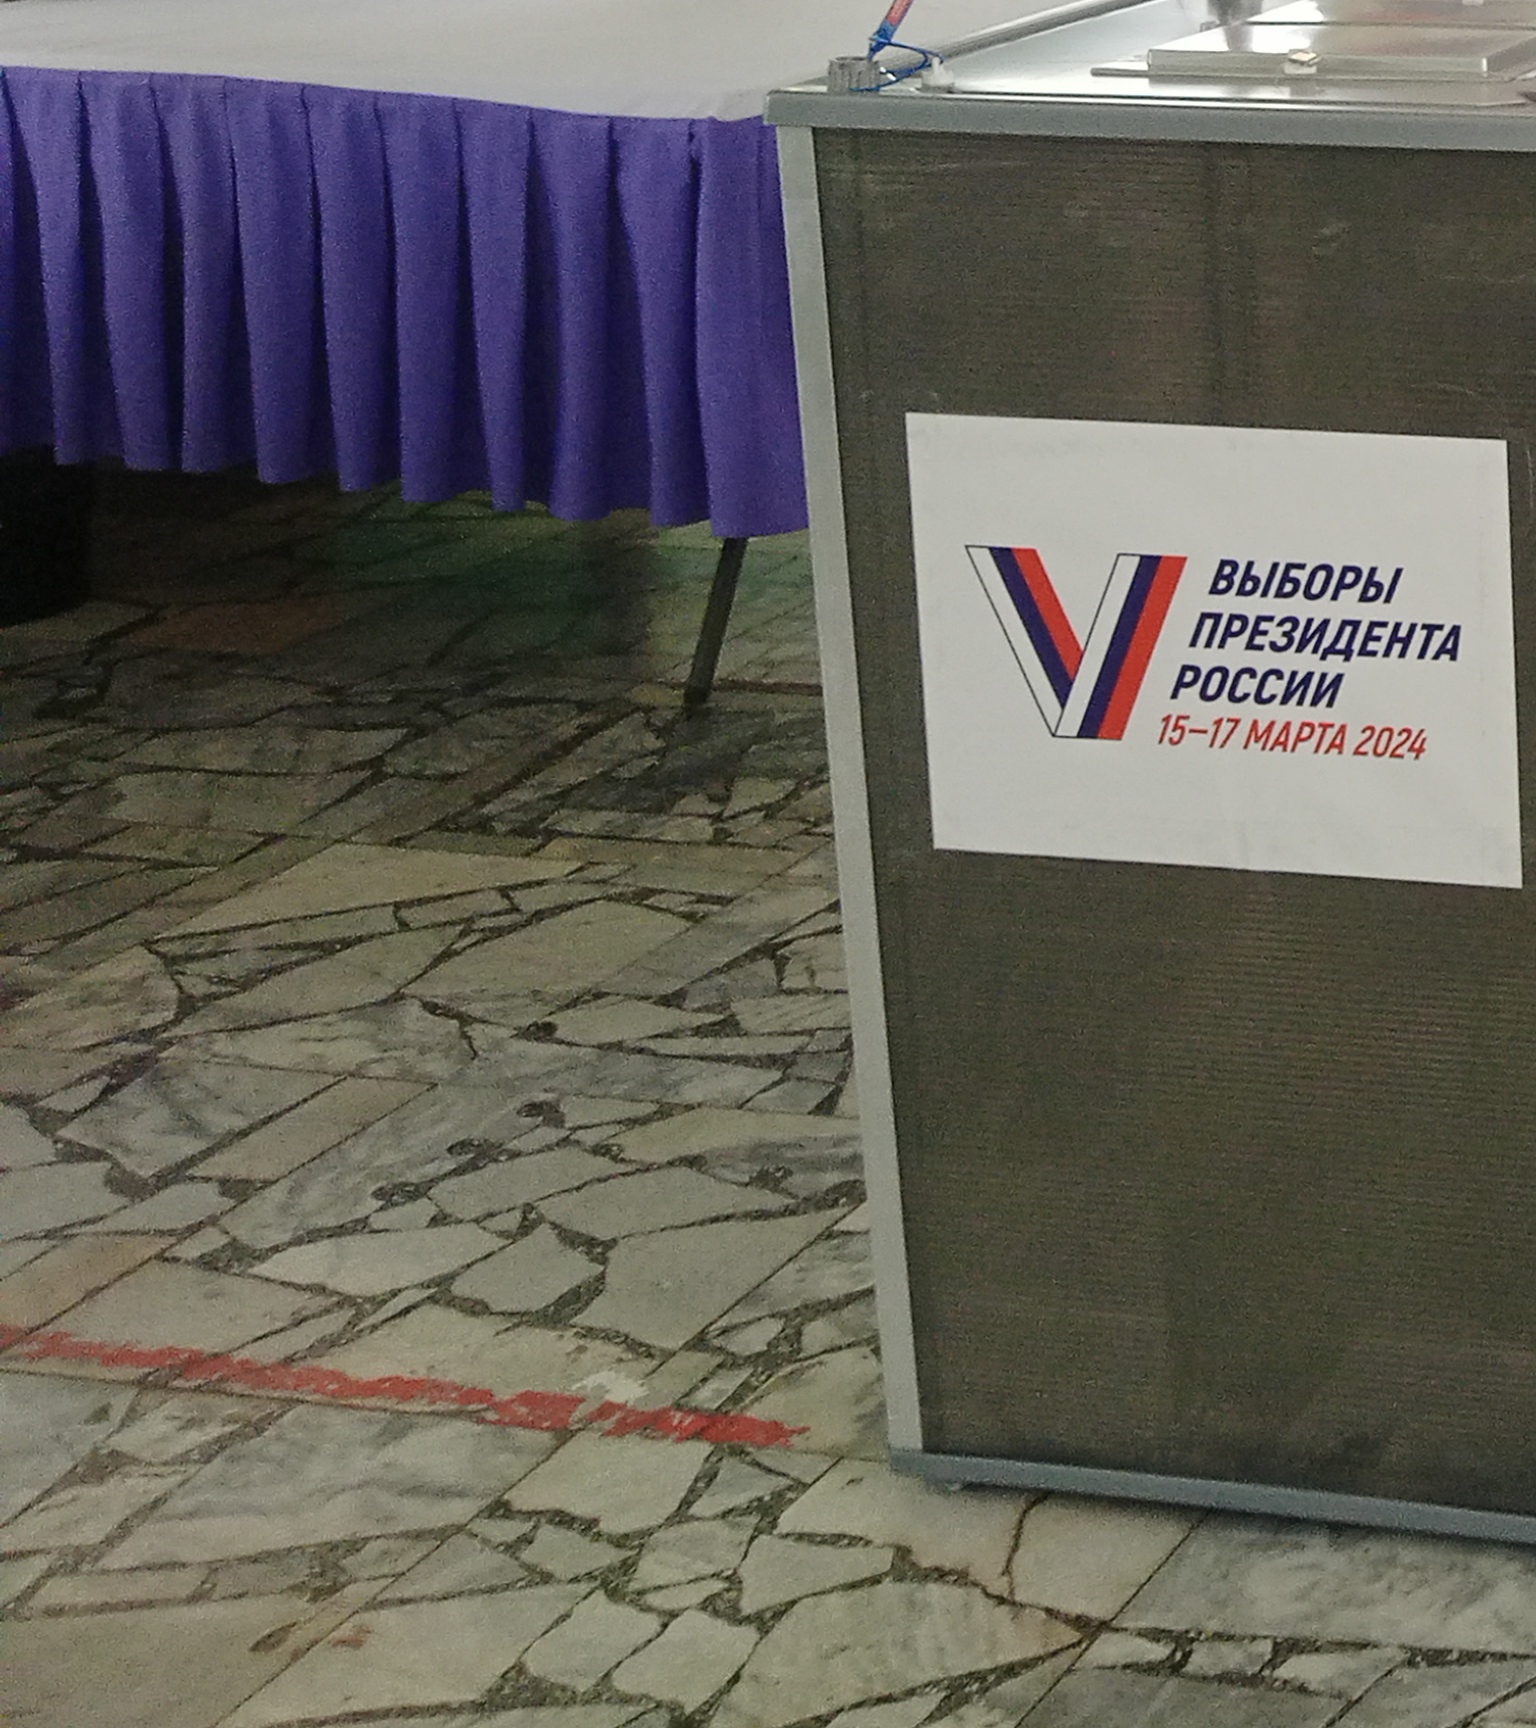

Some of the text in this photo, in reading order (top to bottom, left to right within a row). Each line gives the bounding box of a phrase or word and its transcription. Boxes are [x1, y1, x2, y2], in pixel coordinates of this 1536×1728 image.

[1208, 559, 1404, 604] ВЫБОРЫ
[1188, 612, 1462, 662] ПРЕЗИДЕНТА
[1170, 664, 1345, 708] РОССИИ
[1243, 719, 1348, 755] МАРТА
[1353, 725, 1428, 760] 2024
